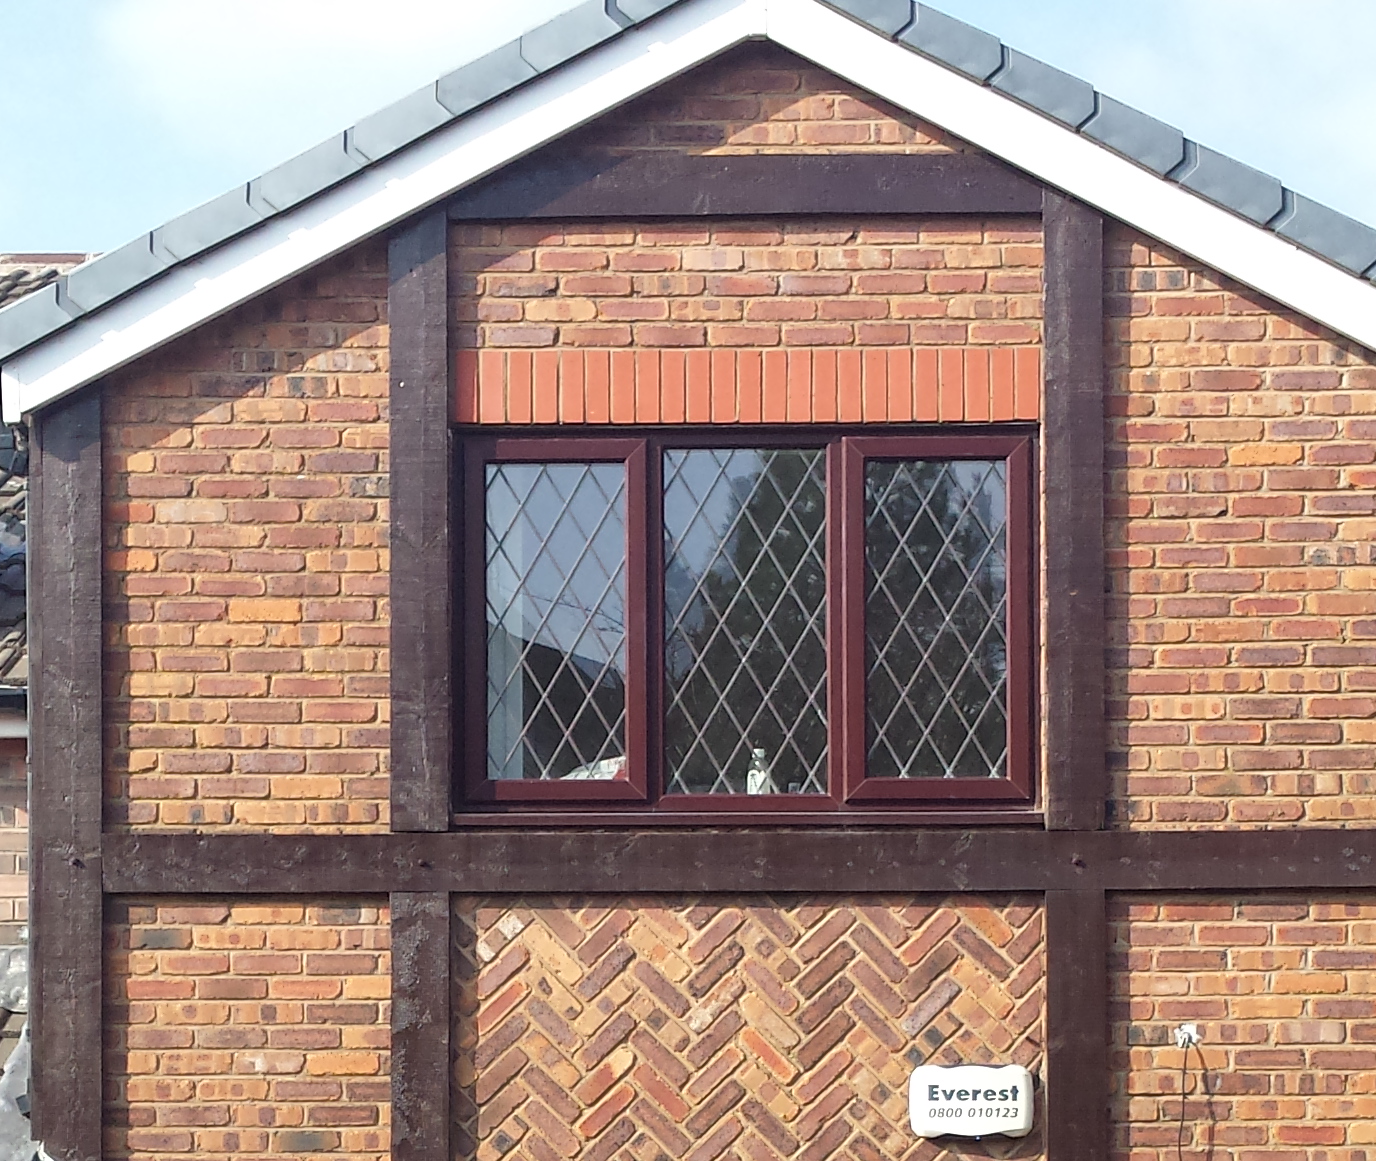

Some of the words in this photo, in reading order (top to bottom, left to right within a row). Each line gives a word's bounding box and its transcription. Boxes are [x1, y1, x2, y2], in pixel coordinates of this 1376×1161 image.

[928, 1085, 1019, 1101] Everest
[929, 1107, 963, 1118] 0800
[968, 1107, 1019, 1118] 010123
